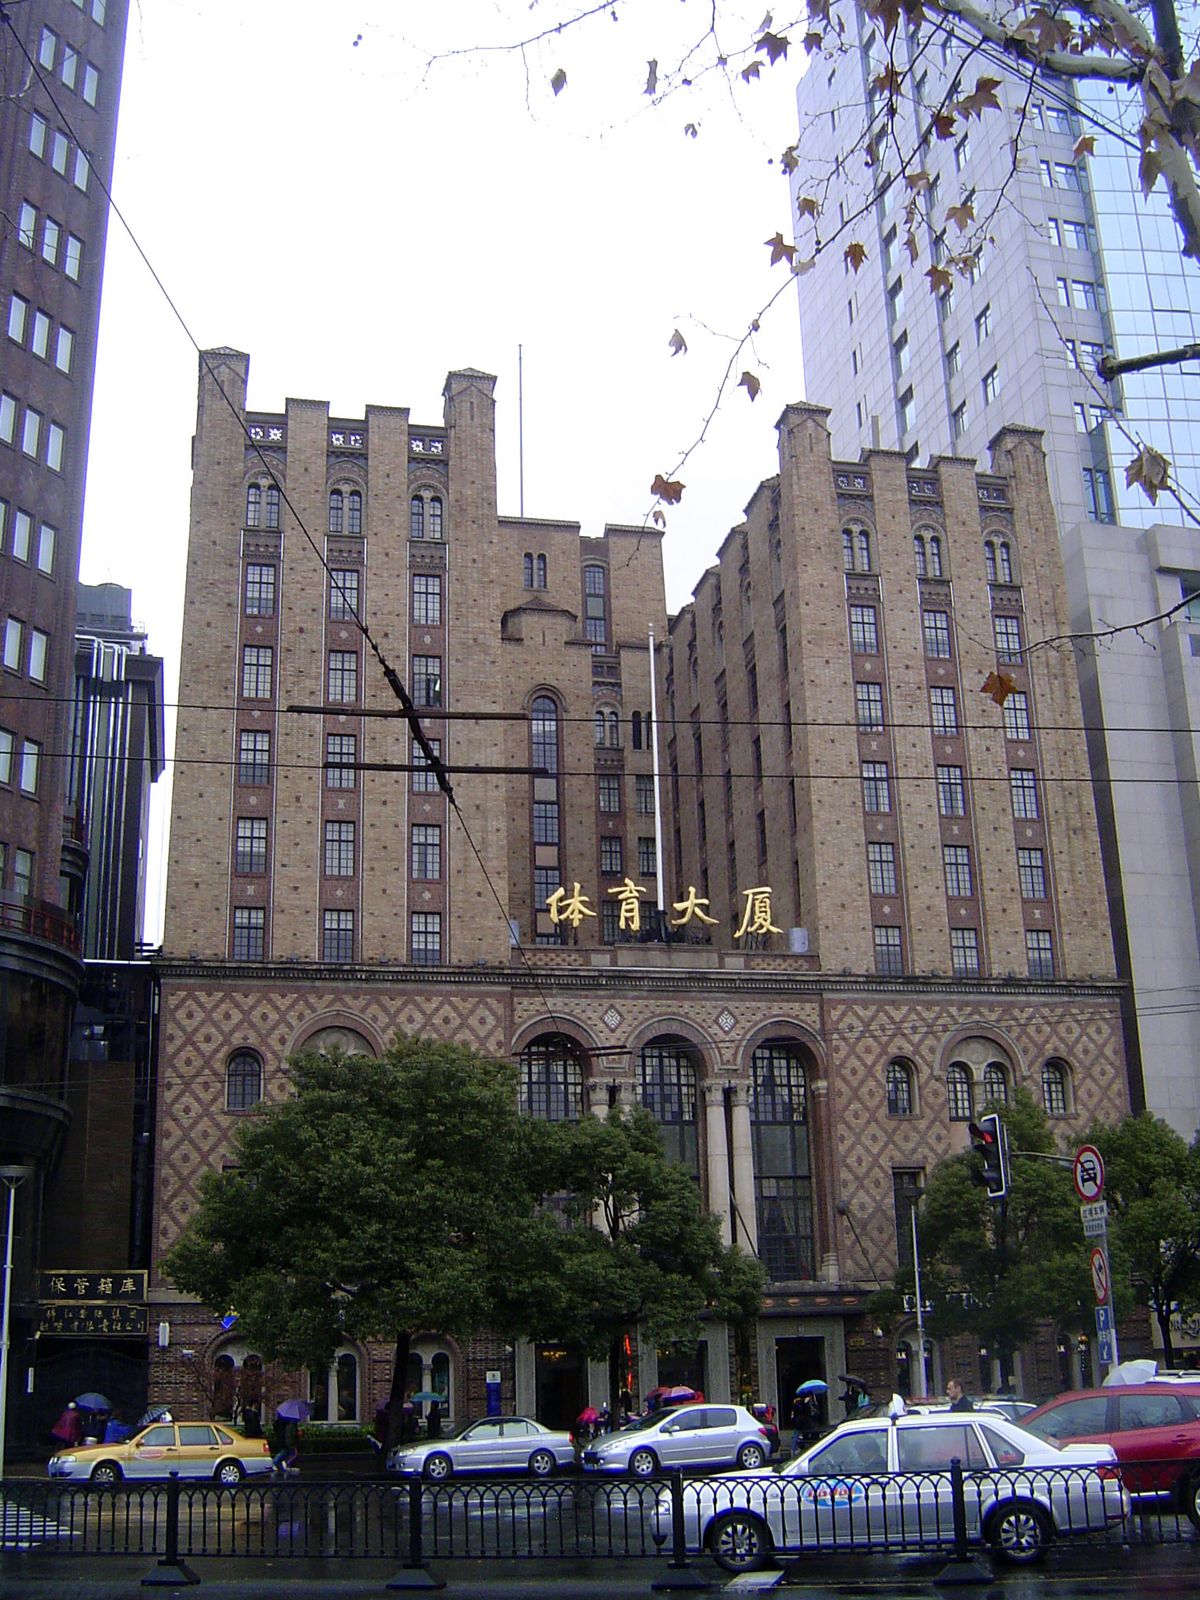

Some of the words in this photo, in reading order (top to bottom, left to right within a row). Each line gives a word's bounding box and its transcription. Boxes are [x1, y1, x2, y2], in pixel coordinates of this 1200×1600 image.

[545, 877, 784, 938] 体育大厦
[49, 1276, 137, 1296] 保管箱库
[1099, 1309, 1106, 1329] P
